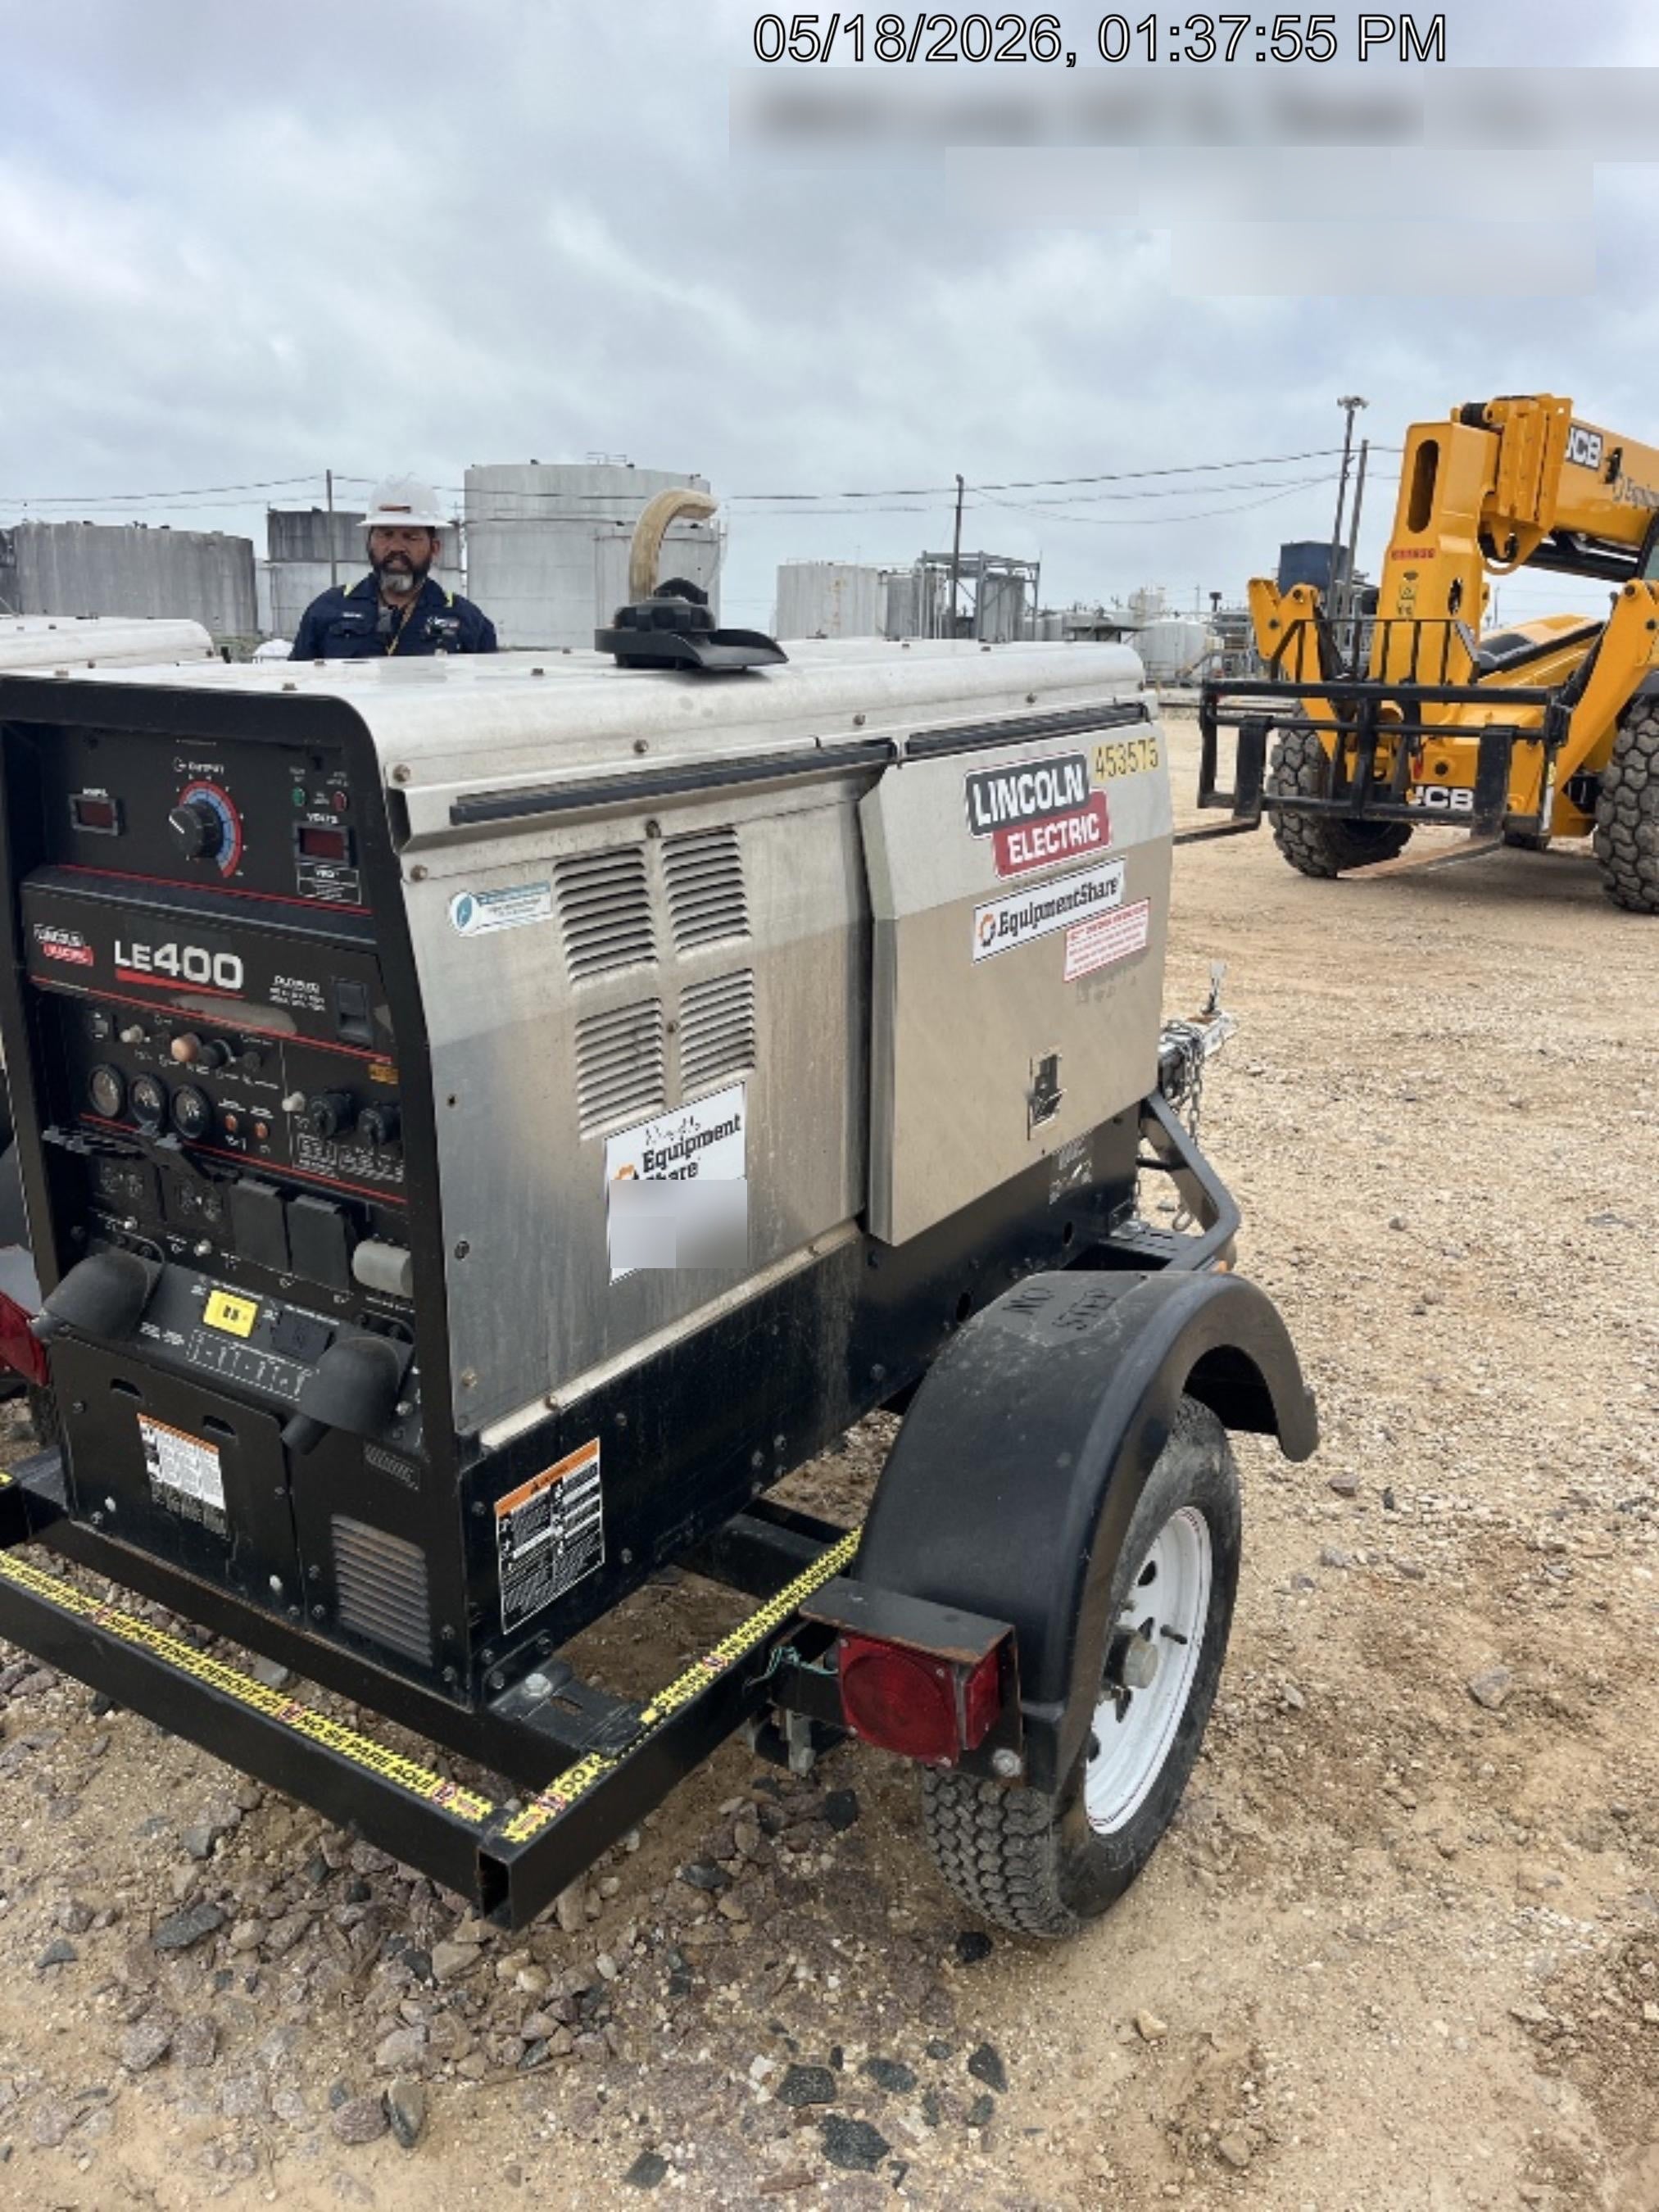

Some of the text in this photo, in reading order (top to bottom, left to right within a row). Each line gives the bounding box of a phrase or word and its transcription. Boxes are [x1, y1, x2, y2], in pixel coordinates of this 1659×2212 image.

[1095, 737, 1159, 779] 453575
[972, 763, 1086, 827] LINCOLN
[1407, 786, 1474, 812] JCB
[1007, 813, 1100, 864] ELECTRIC
[997, 877, 1120, 937] EquipmentShare
[114, 940, 244, 990] LE400
[643, 1113, 741, 1173] Equipment
[295, 1714, 326, 1735] NO
[320, 1726, 350, 1747] SE
[343, 1738, 394, 1770] PARE
